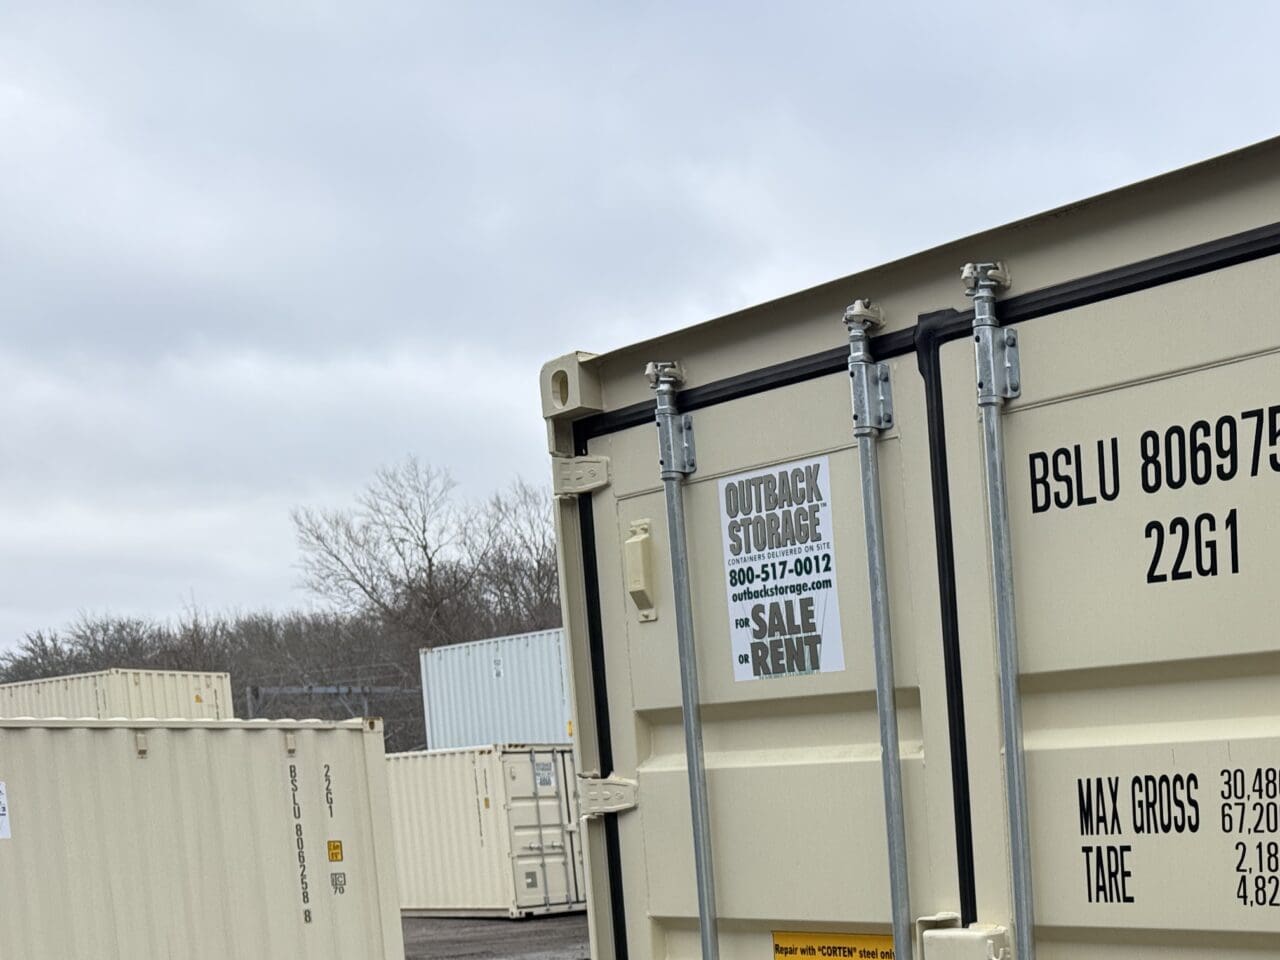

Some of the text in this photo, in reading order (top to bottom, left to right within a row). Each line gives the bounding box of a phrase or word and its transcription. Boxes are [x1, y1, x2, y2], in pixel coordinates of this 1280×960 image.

[725, 463, 823, 518] OUTBACK
[1029, 437, 1120, 513] BSLU
[728, 504, 821, 556] STORAGE
[728, 542, 831, 566] CONTAINERS DELIVERED ON SITE
[1145, 508, 1239, 583] 22G1
[729, 553, 831, 587] 800-517-0012
[732, 579, 832, 602] outbackstorage.com
[735, 597, 816, 639] FOR SALE
[738, 634, 821, 676] OR RENT
[324, 764, 333, 818] 22G1
[1077, 776, 1122, 836] MAX
[1131, 773, 1200, 834] GROSS
[289, 765, 312, 923] BSLU 806258 8
[1081, 845, 1135, 903] TARE
[775, 944, 798, 957] Repair
[800, 944, 816, 956] with
[859, 948, 878, 959] steel
